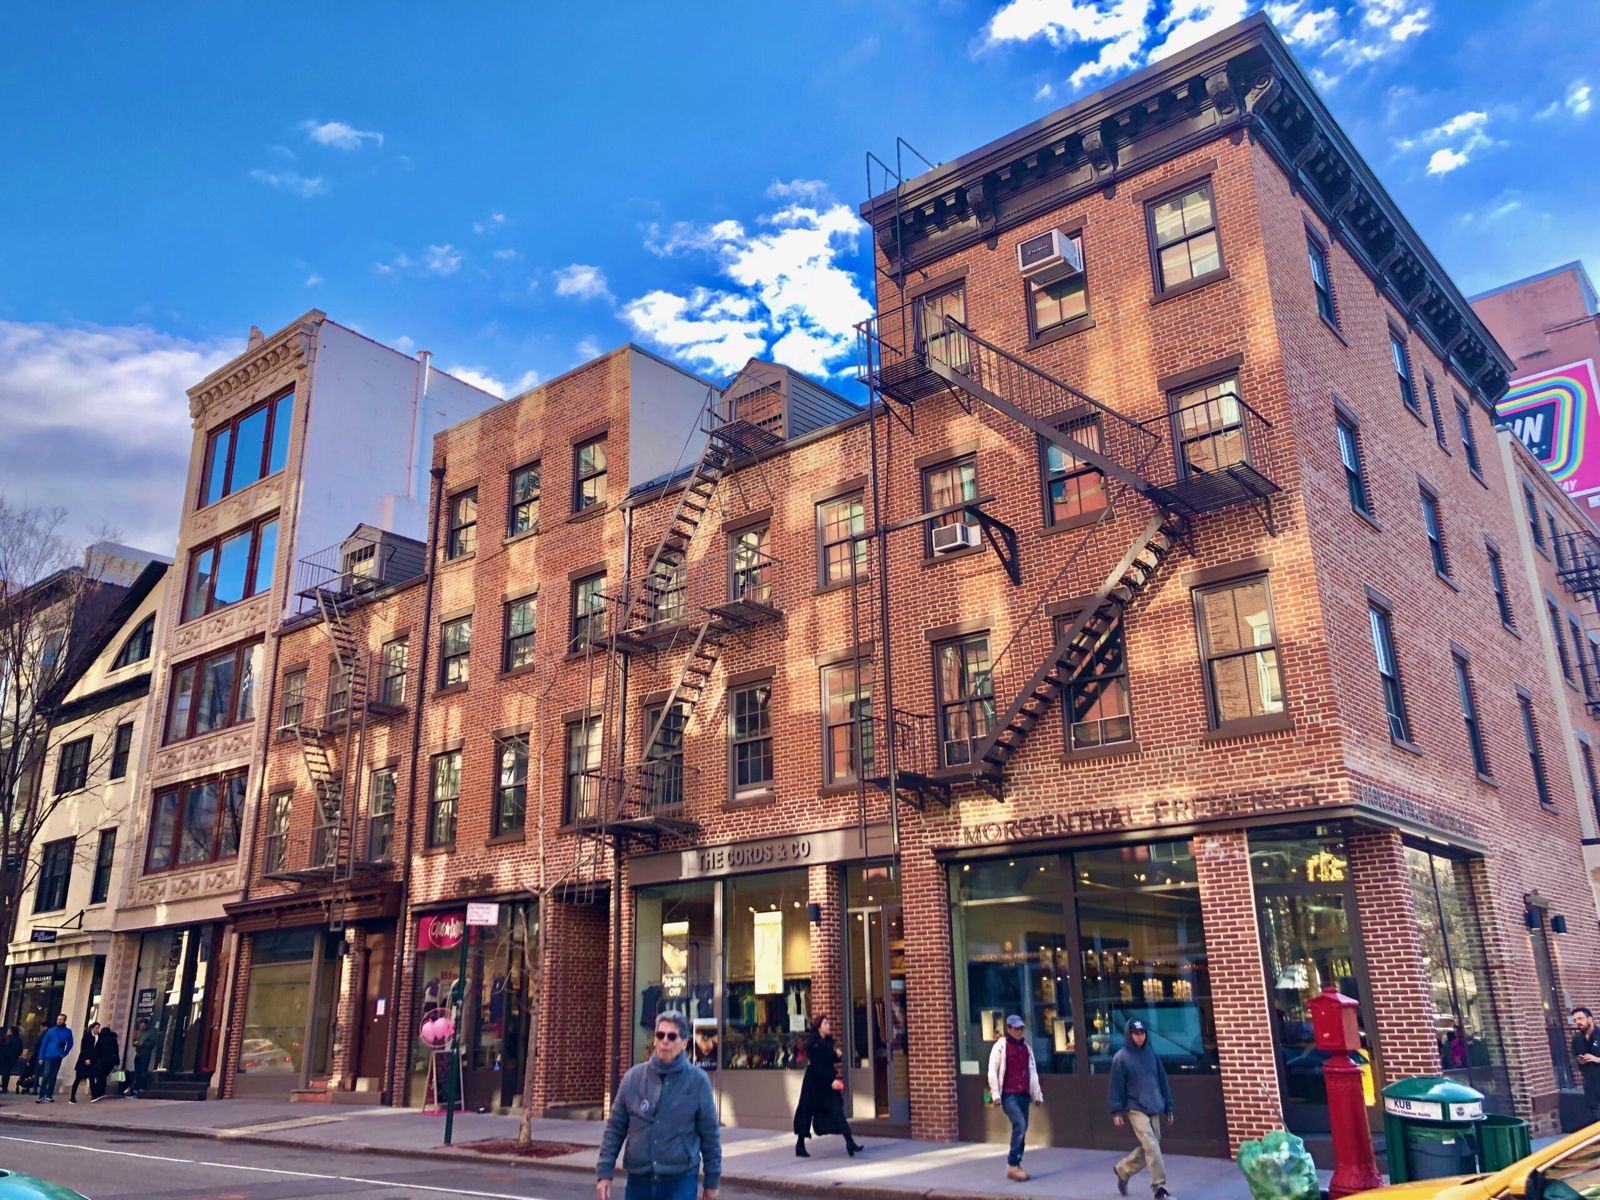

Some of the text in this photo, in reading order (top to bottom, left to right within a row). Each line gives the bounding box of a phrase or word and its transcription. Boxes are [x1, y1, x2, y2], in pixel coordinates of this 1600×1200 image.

[699, 839, 811, 872] THE CORDS & CO
